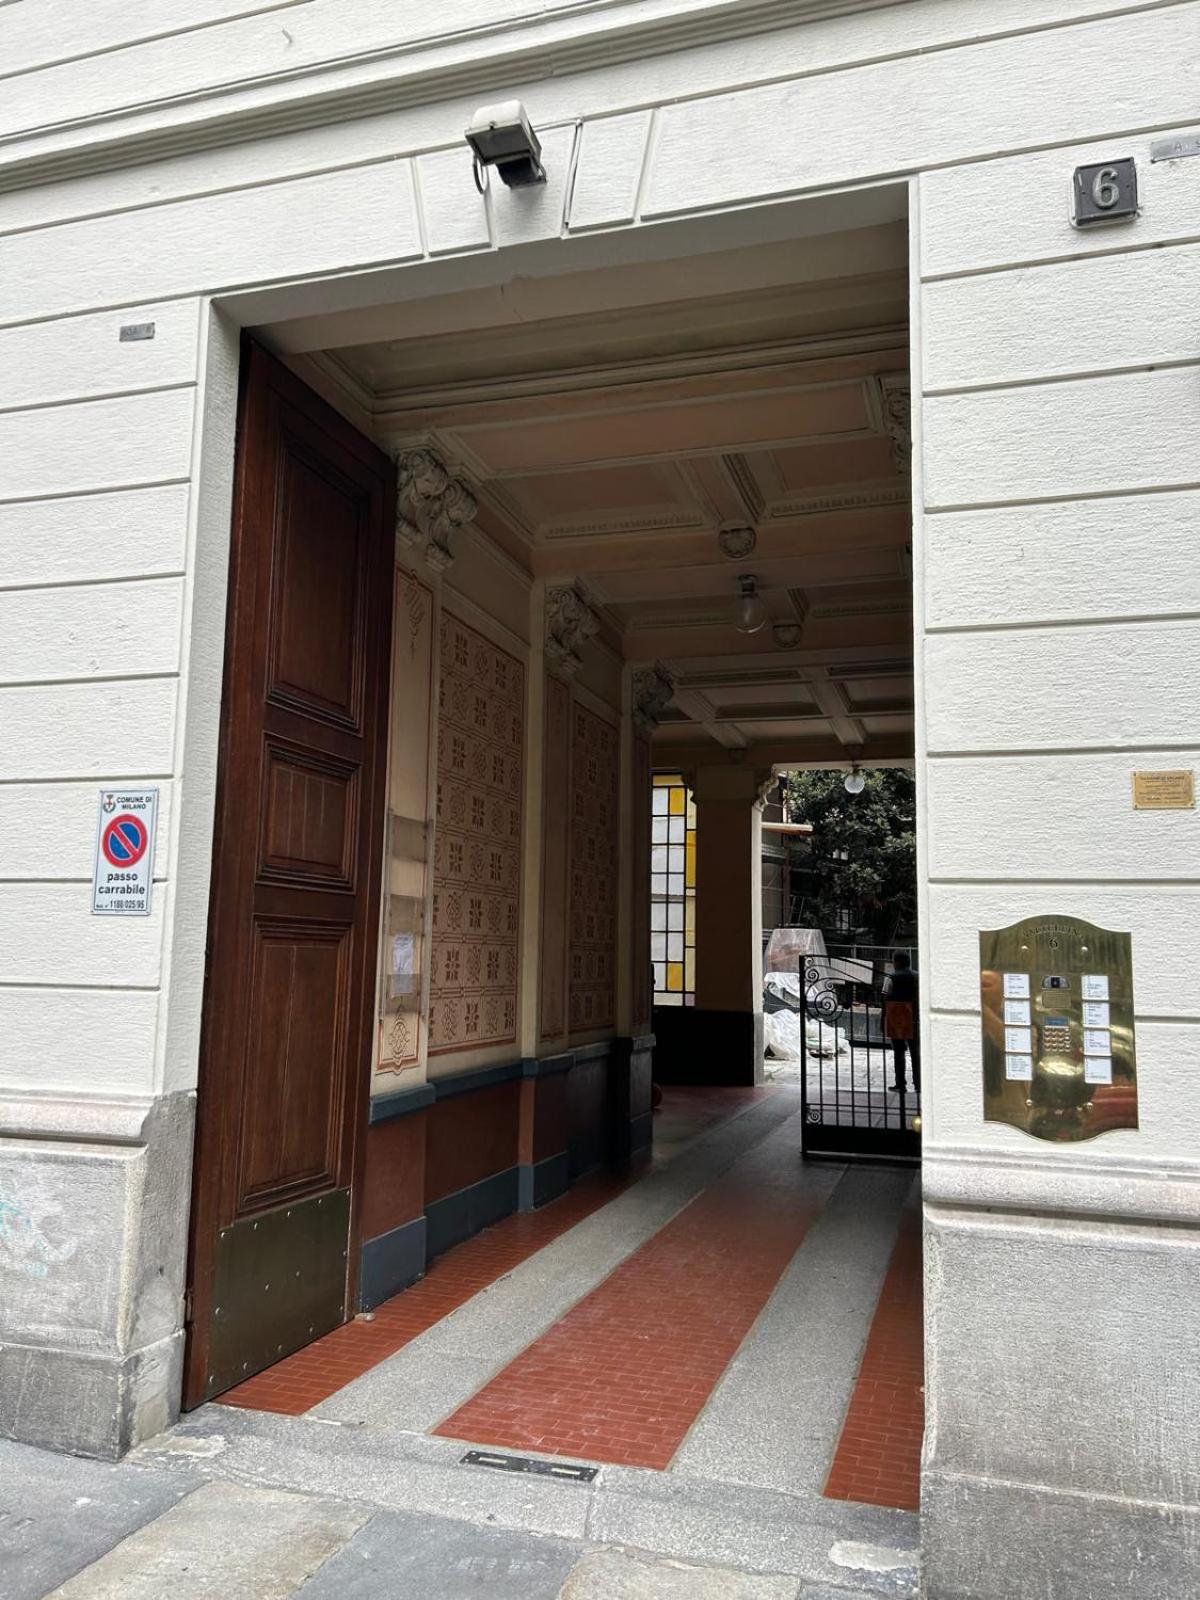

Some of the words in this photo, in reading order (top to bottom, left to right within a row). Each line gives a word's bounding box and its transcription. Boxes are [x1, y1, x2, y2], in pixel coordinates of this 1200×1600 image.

[1092, 167, 1120, 209] 6
[116, 796, 144, 804] COMUNE
[145, 795, 153, 803] DI
[107, 872, 138, 883] passo
[98, 885, 145, 895] carrabile
[1049, 937, 1059, 949] 6
